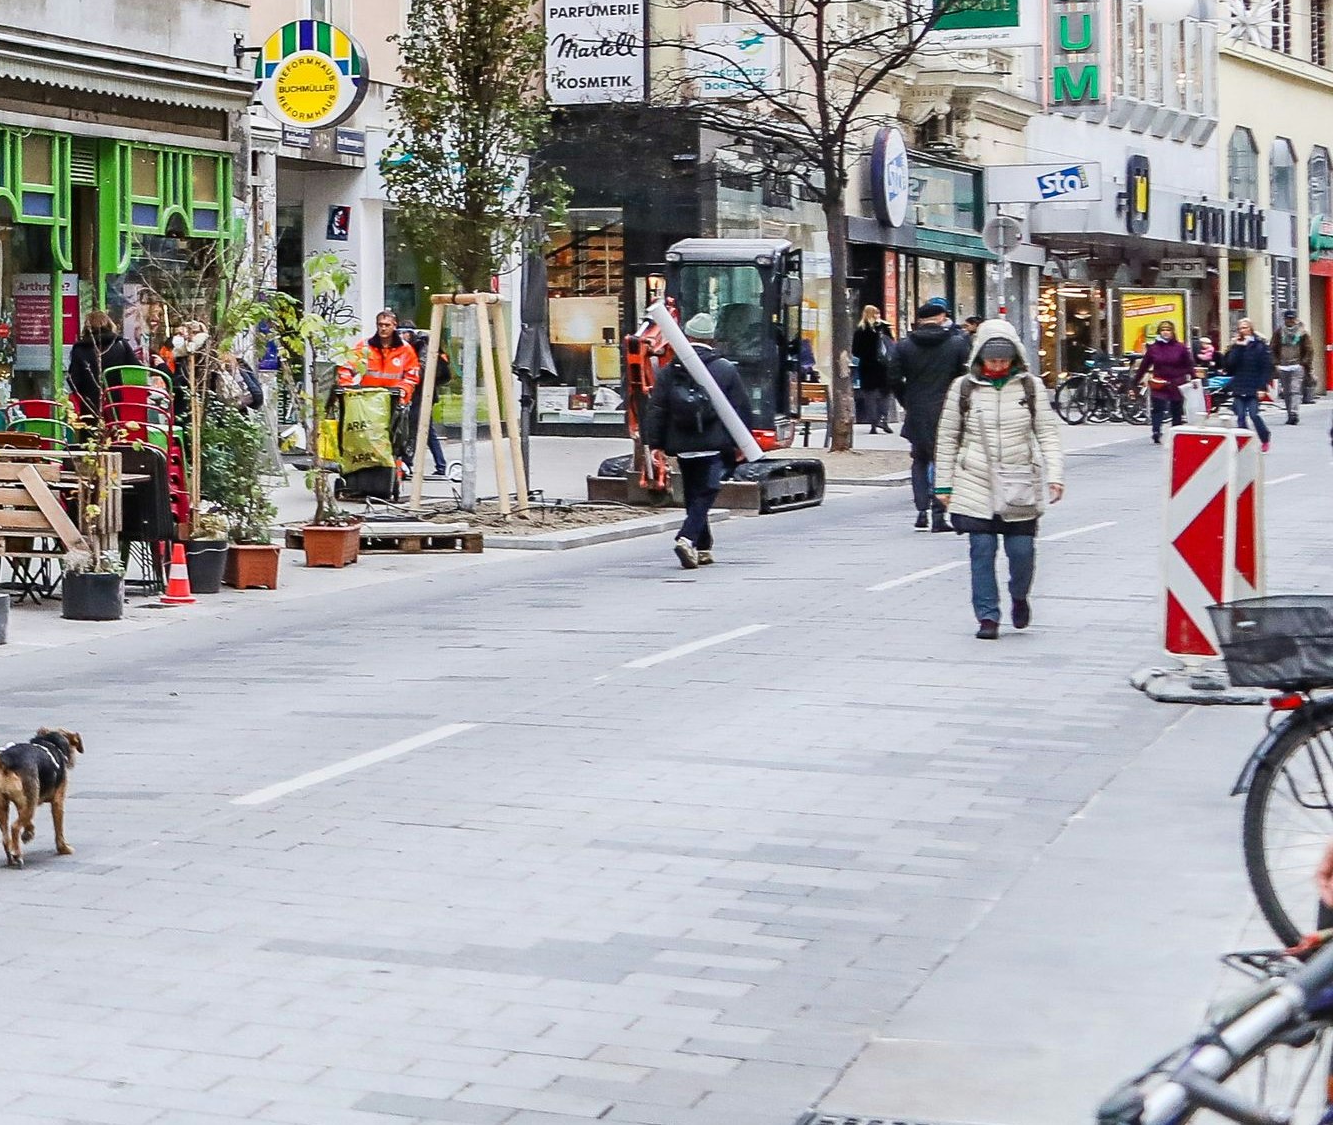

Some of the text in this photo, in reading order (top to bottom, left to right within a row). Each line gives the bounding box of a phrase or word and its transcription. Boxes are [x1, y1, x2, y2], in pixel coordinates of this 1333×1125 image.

[550, 31, 638, 59] Martell
[278, 58, 337, 85] REFORMHAUS
[557, 75, 633, 89] KOSMETIK
[279, 83, 336, 94] BUCHMÜLLER
[278, 94, 337, 121] REFORMHAUS
